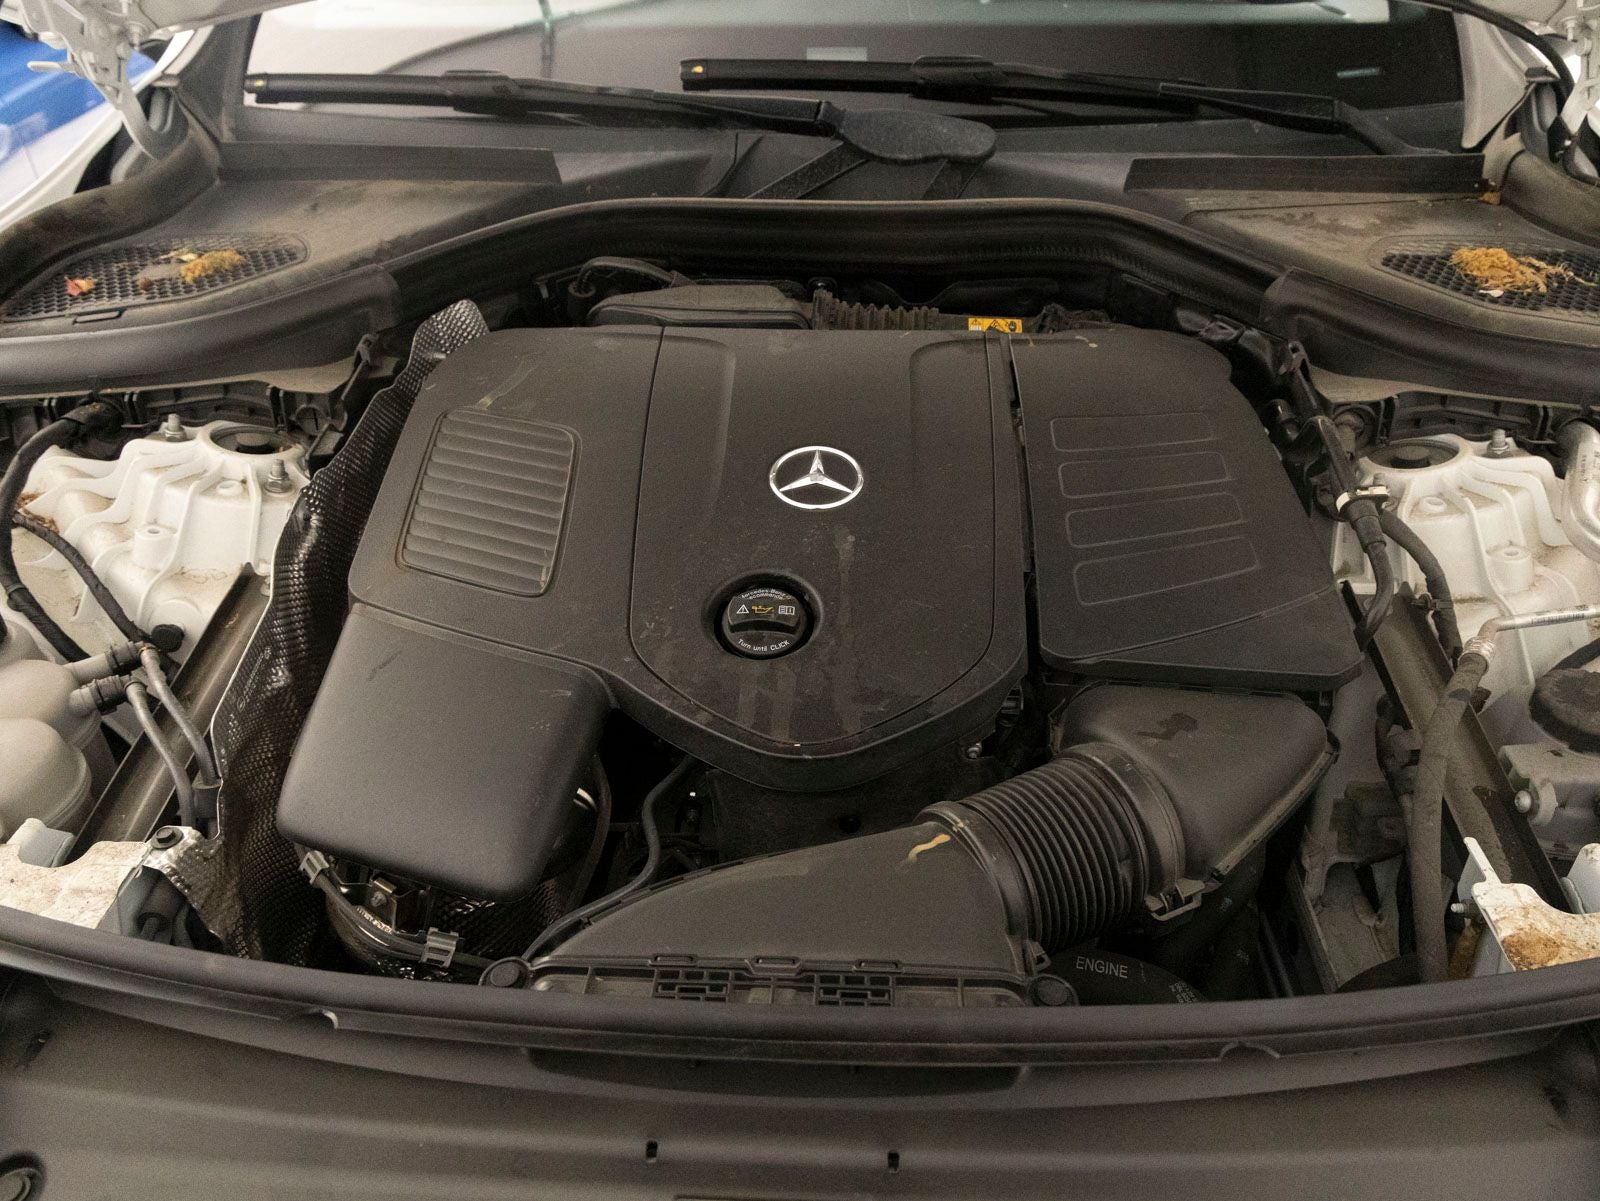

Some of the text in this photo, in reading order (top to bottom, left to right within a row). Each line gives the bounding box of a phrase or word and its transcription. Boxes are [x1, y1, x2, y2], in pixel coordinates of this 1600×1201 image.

[738, 638, 751, 649] Turn
[770, 640, 790, 651] CLICK
[1076, 956, 1128, 979] ENGINE
